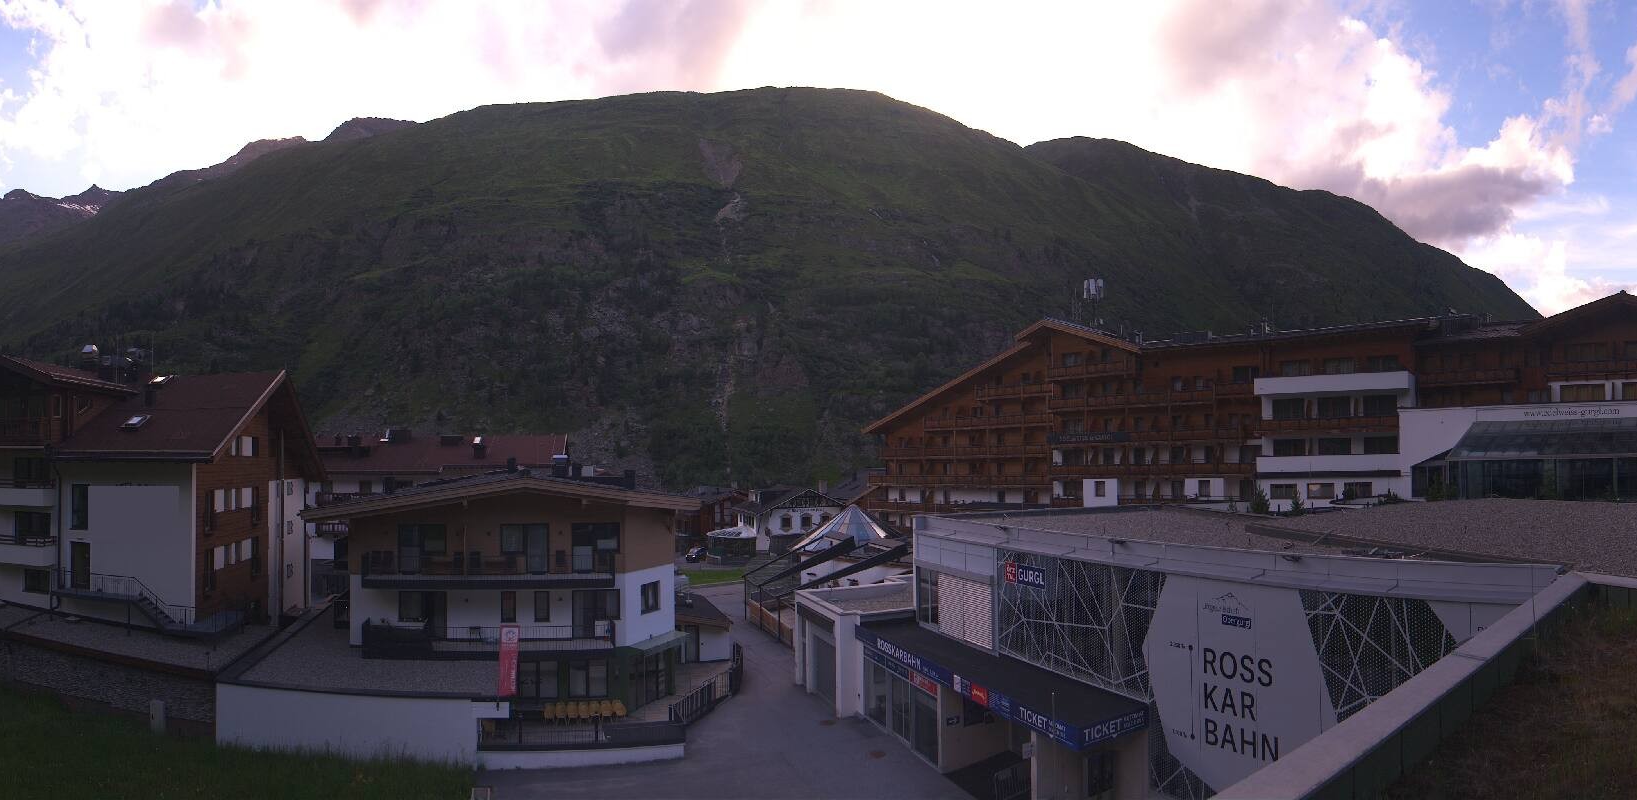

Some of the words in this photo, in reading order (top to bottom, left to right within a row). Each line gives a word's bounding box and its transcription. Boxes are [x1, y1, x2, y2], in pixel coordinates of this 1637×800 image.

[1523, 407, 1620, 418] www.edelweiss-gurgl.com
[1018, 568, 1045, 586] GURGL
[876, 637, 922, 671] ROSSKARBAHN
[1203, 647, 1273, 687] ROSS
[1203, 682, 1257, 722] KAR
[1019, 706, 1048, 730] TICKET
[1083, 718, 1123, 742] TICKET
[1204, 718, 1279, 762] BAHN
